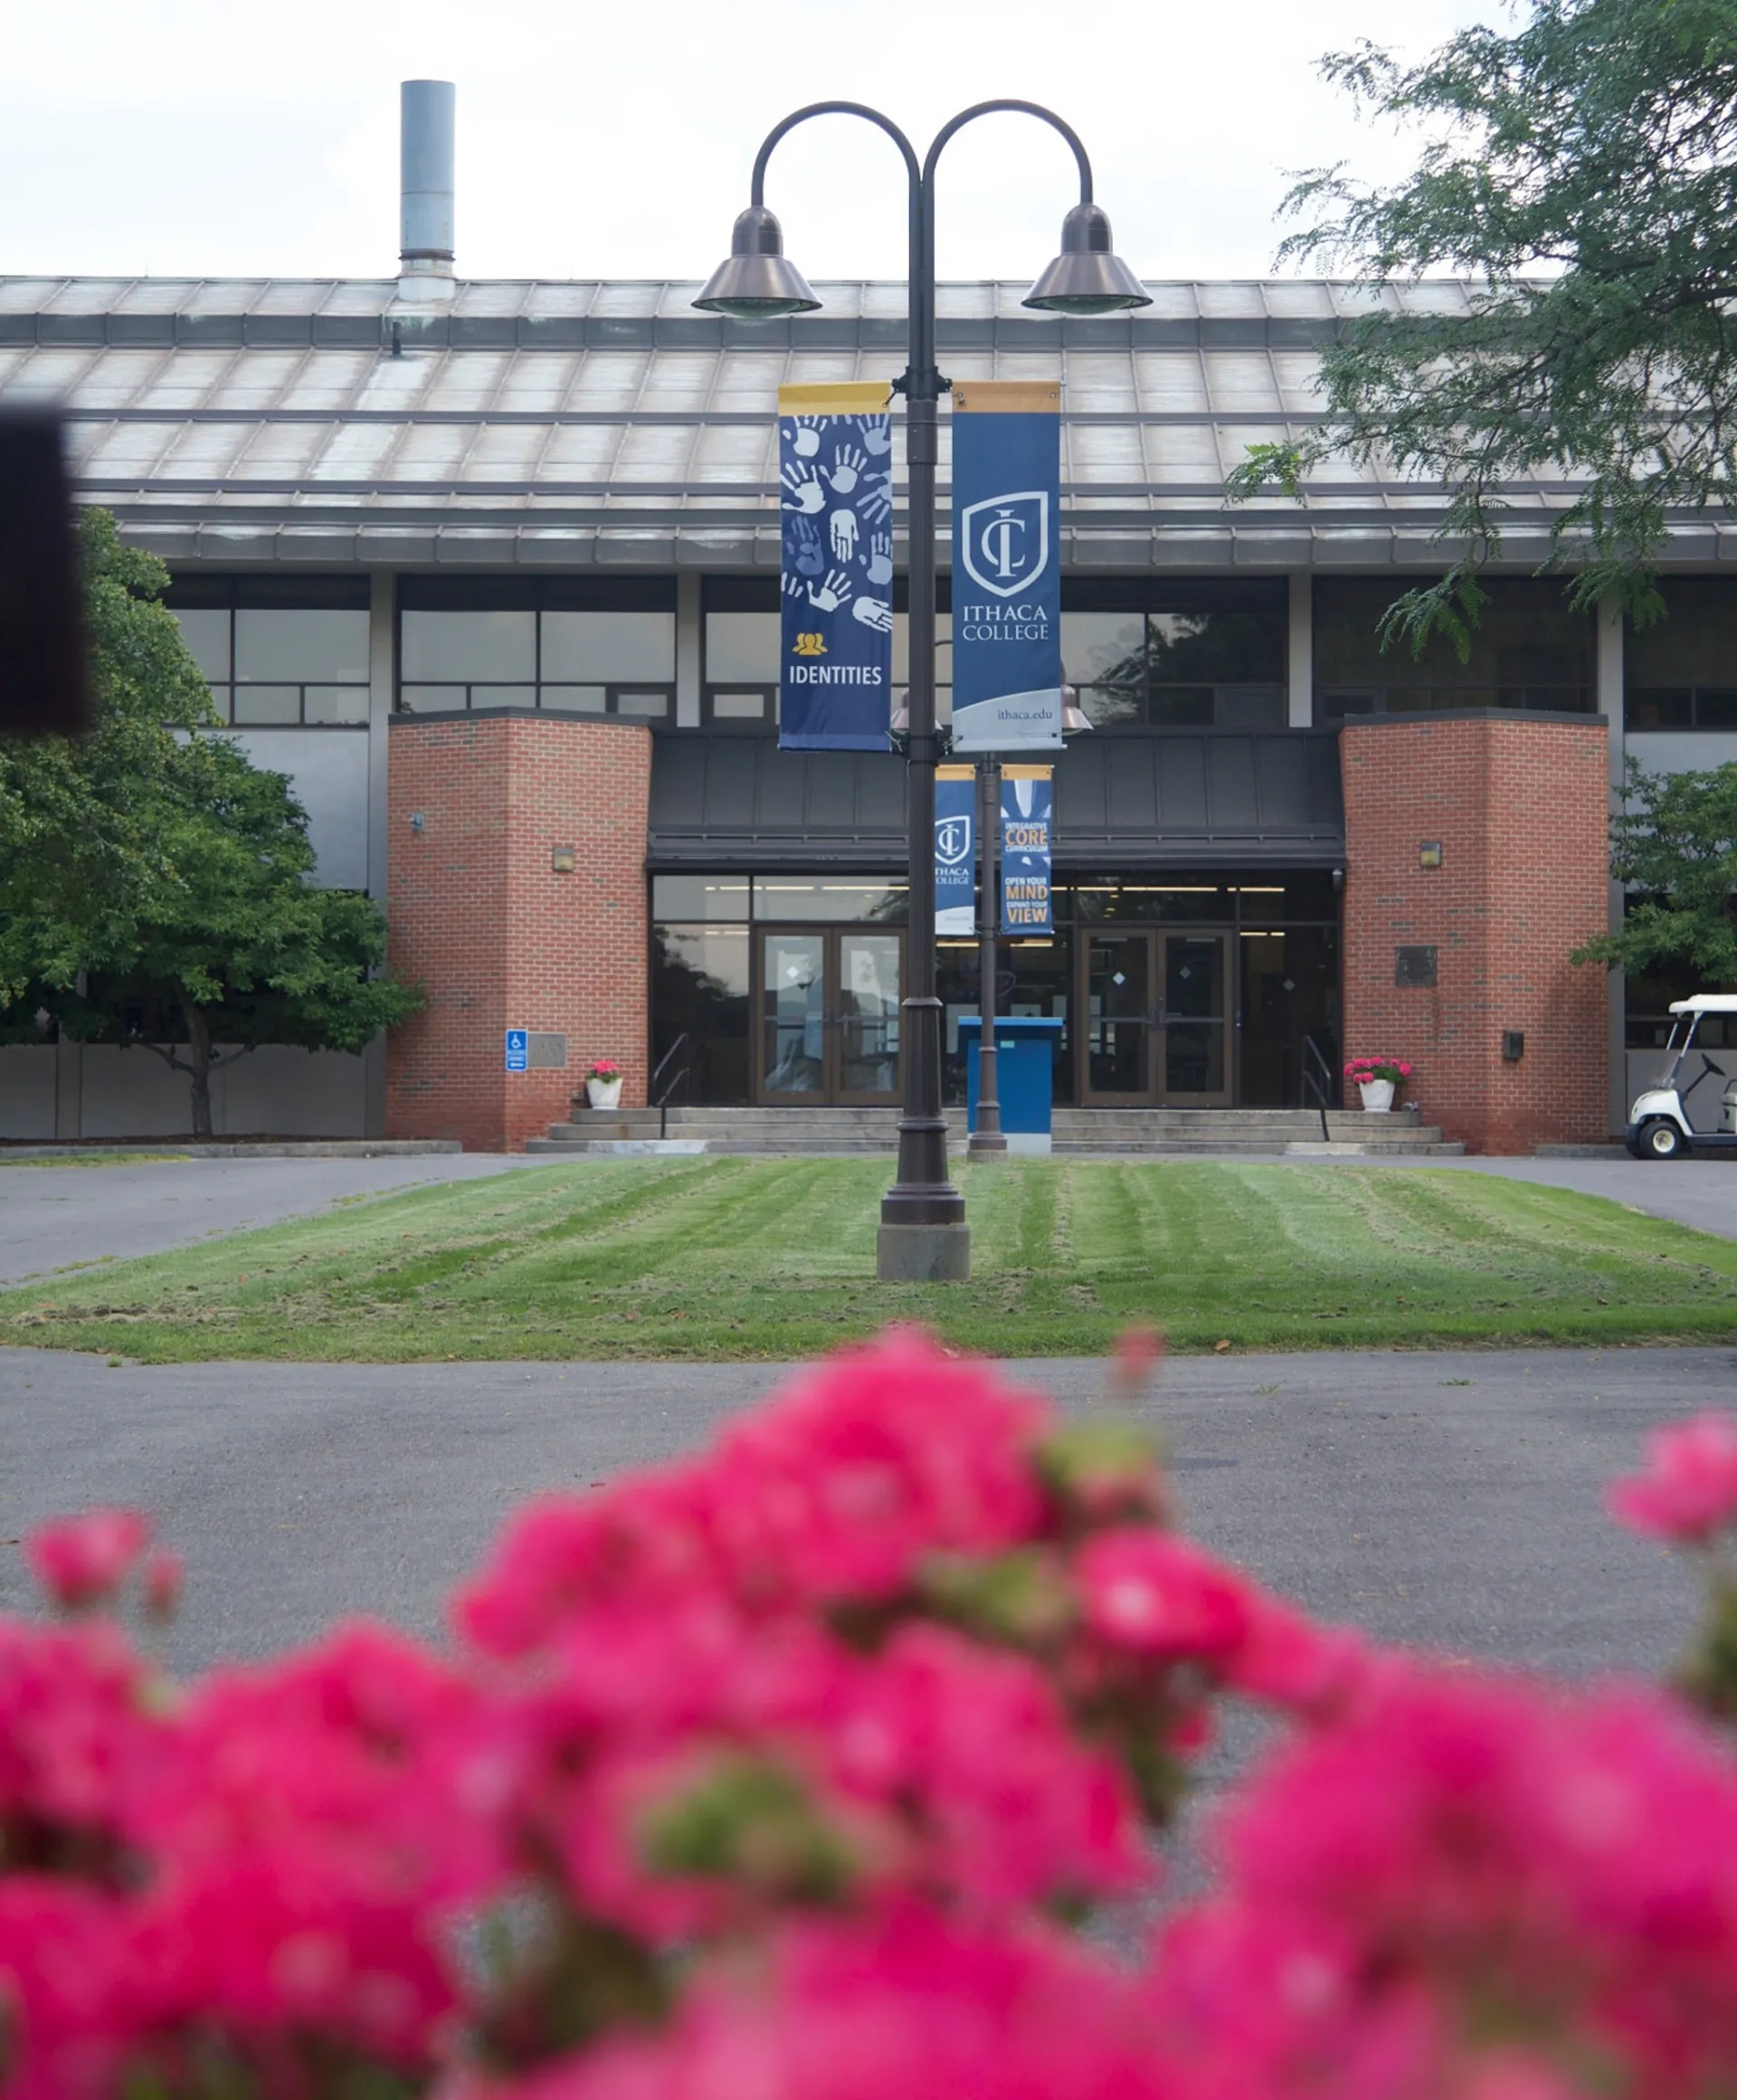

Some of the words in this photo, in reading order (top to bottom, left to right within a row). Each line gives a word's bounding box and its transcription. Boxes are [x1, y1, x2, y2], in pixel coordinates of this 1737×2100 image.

[963, 604, 1048, 622] ITHACA
[963, 624, 1049, 641] COLLEGE
[790, 665, 882, 685] IDENTITIES
[997, 708, 1052, 720] ithaca.edu
[1005, 822, 1047, 831] INTEGRATIVE
[1005, 830, 1048, 845] CORE
[935, 868, 970, 876] THACA
[935, 877, 969, 885] OLLEGE
[1005, 877, 1025, 885] OPEN
[1026, 877, 1047, 885] YOUR
[1005, 886, 1048, 899] MIND
[1007, 907, 1048, 923] VIEW
